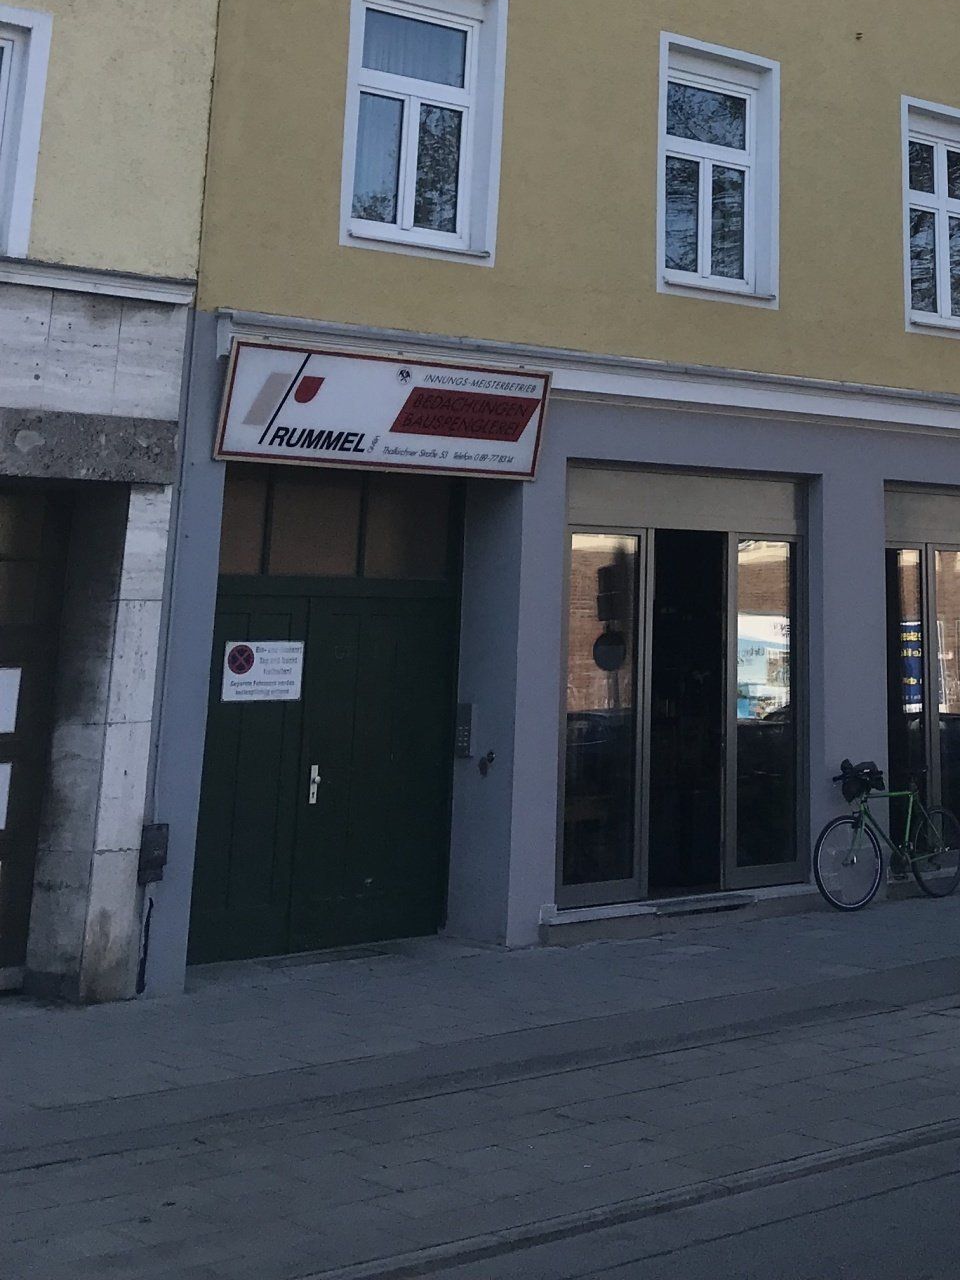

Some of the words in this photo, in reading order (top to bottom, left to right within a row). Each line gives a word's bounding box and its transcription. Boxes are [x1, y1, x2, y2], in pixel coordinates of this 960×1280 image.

[413, 393, 527, 417] BEDACHUNGEN
[403, 412, 519, 435] BAUSPENGLEREI
[268, 426, 366, 453] RUMMEL
